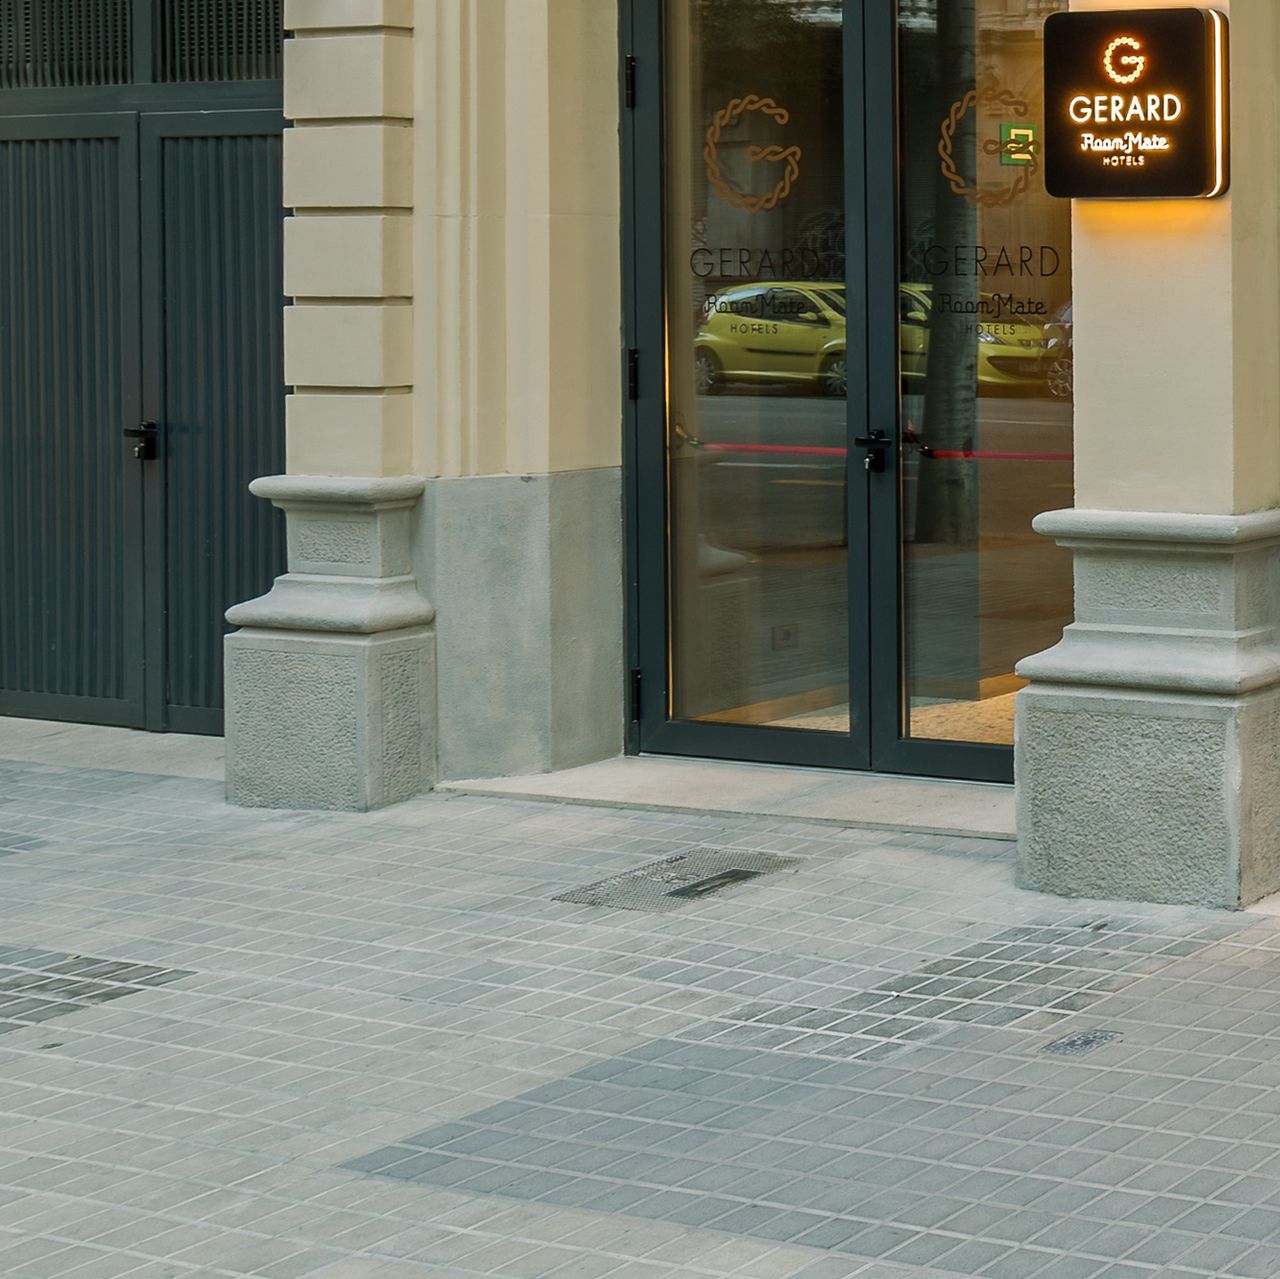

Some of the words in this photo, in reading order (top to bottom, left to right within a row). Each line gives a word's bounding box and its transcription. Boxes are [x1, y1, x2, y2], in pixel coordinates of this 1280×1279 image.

[1068, 93, 1182, 123] GERARD
[1102, 155, 1145, 167] HOTELS
[689, 246, 820, 278] GERARD
[923, 245, 1061, 278] GERARD
[730, 323, 779, 335] HOTELS
[965, 323, 1017, 336] HOTELS
